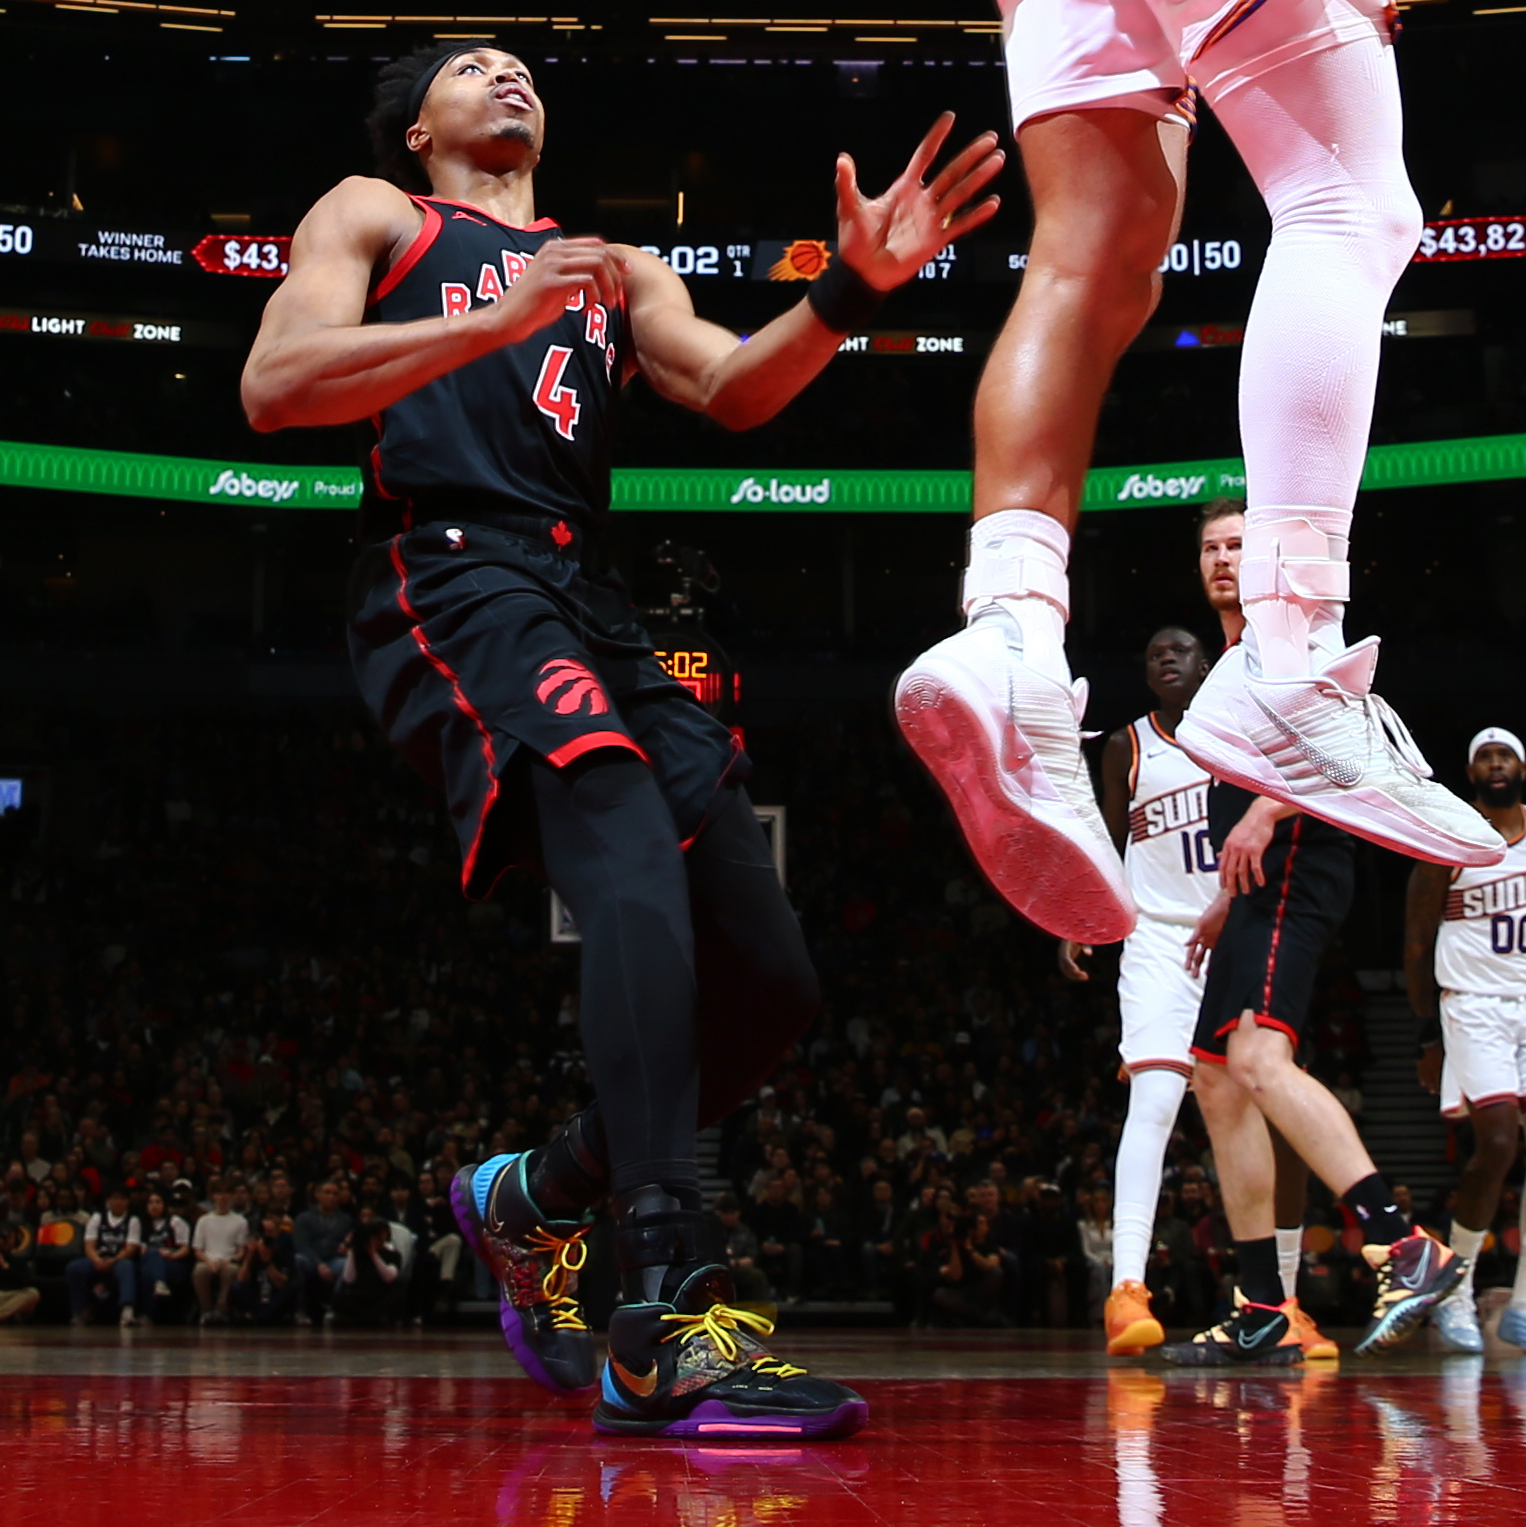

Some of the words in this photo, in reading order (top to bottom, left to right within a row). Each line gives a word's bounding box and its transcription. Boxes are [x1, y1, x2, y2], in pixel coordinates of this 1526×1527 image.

[98, 230, 166, 250] WINNER
[727, 244, 751, 259] QTR
[79, 243, 131, 262] TAKES
[134, 247, 184, 265] HOME
[732, 261, 745, 278] 1
[29, 315, 87, 336] LIGHT
[132, 322, 183, 343] ZONE
[915, 335, 965, 354] ZONE
[531, 343, 582, 442] 4
[208, 469, 300, 503] Sobeys
[313, 480, 356, 497] Proud
[1116, 474, 1206, 501] Sobeys
[1181, 830, 1220, 874] 10
